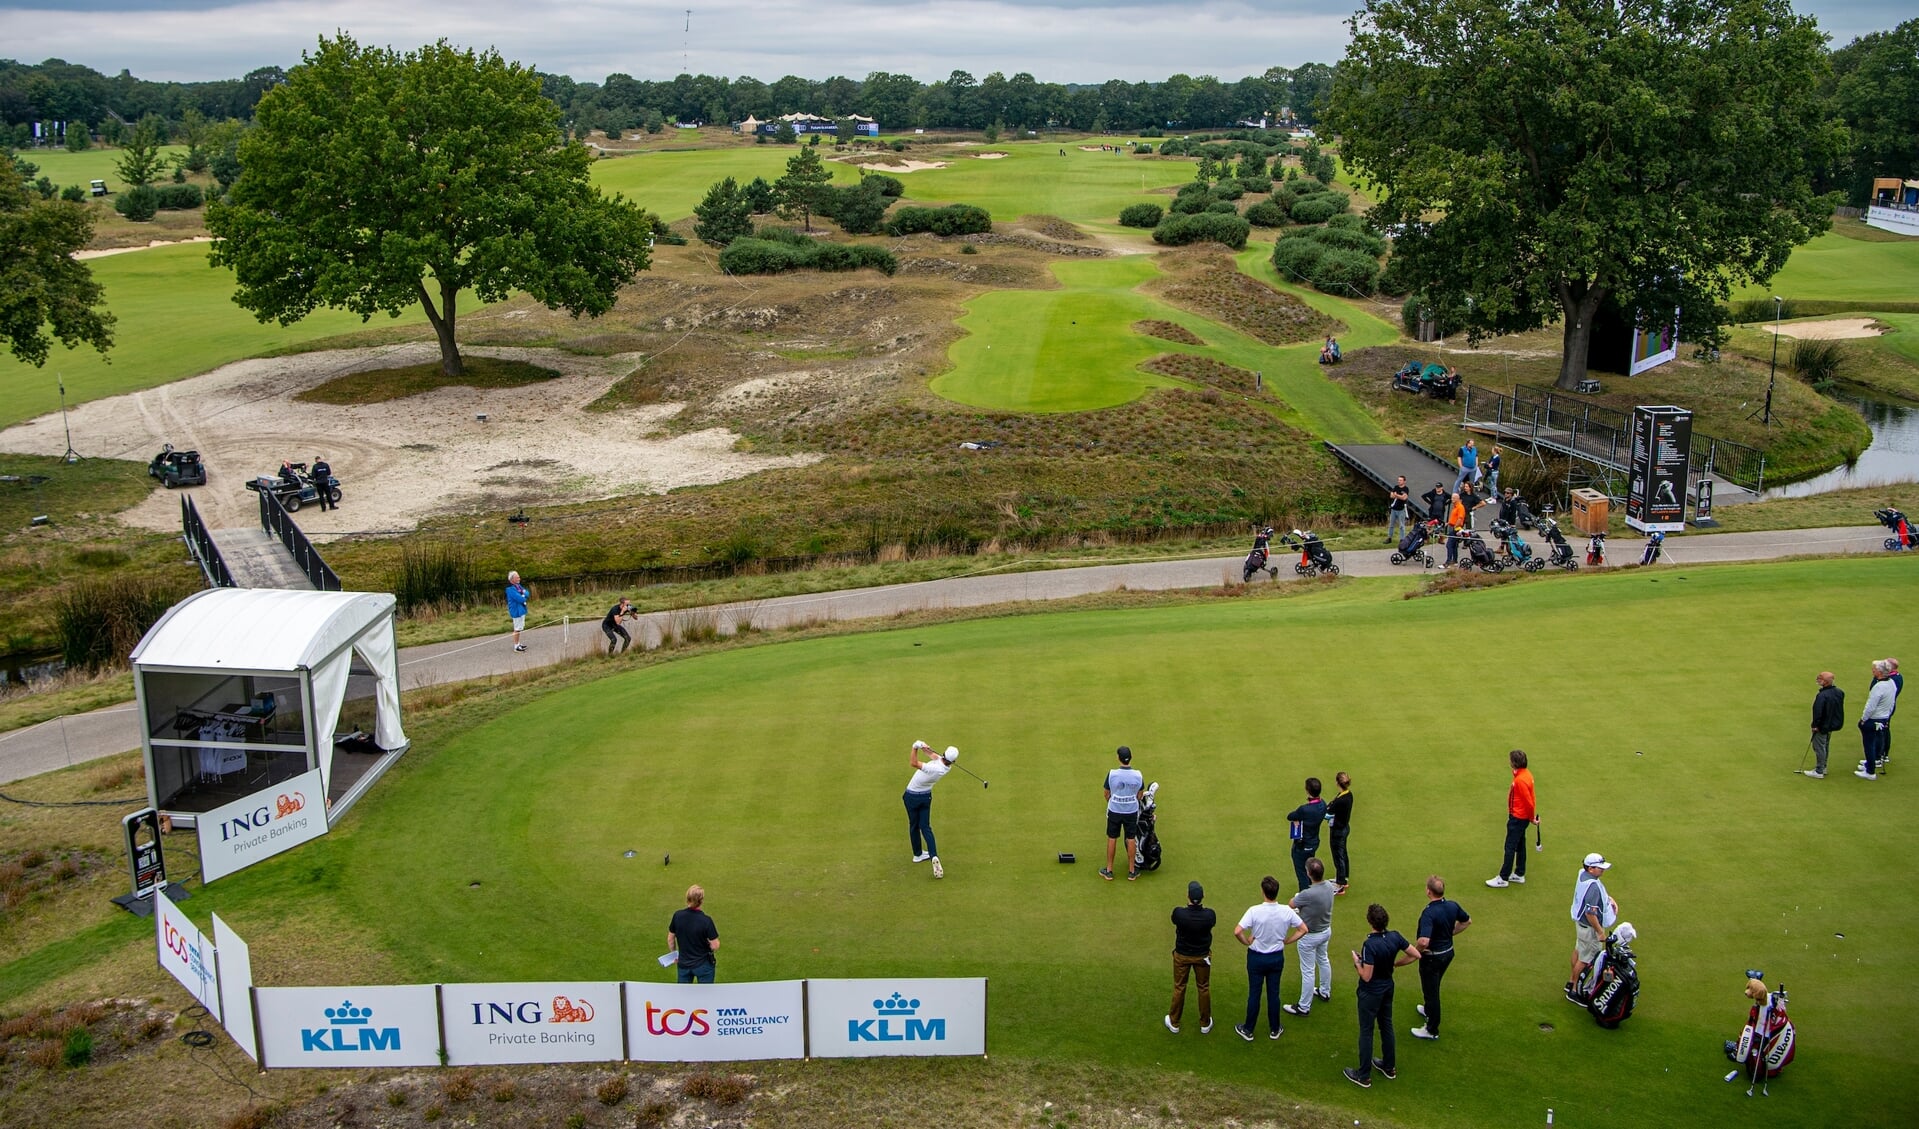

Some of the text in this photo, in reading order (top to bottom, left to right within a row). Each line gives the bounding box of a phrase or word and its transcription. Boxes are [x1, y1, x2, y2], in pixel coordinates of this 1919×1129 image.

[223, 754, 242, 763] FOX
[220, 805, 271, 842] ING
[233, 817, 308, 854] Private Banking
[163, 913, 188, 964] tcs
[1593, 975, 1623, 1014] SRIXON
[471, 1001, 543, 1025] ING
[645, 1000, 710, 1036] tcs
[716, 1008, 748, 1017] TATA
[717, 1015, 789, 1027] CONSULTANCY
[301, 1028, 401, 1051] KLM
[489, 1031, 595, 1046] Private Banking
[717, 1026, 764, 1036] SERVICES
[848, 1018, 946, 1041] KLM
[1768, 1028, 1792, 1065] Wilson
